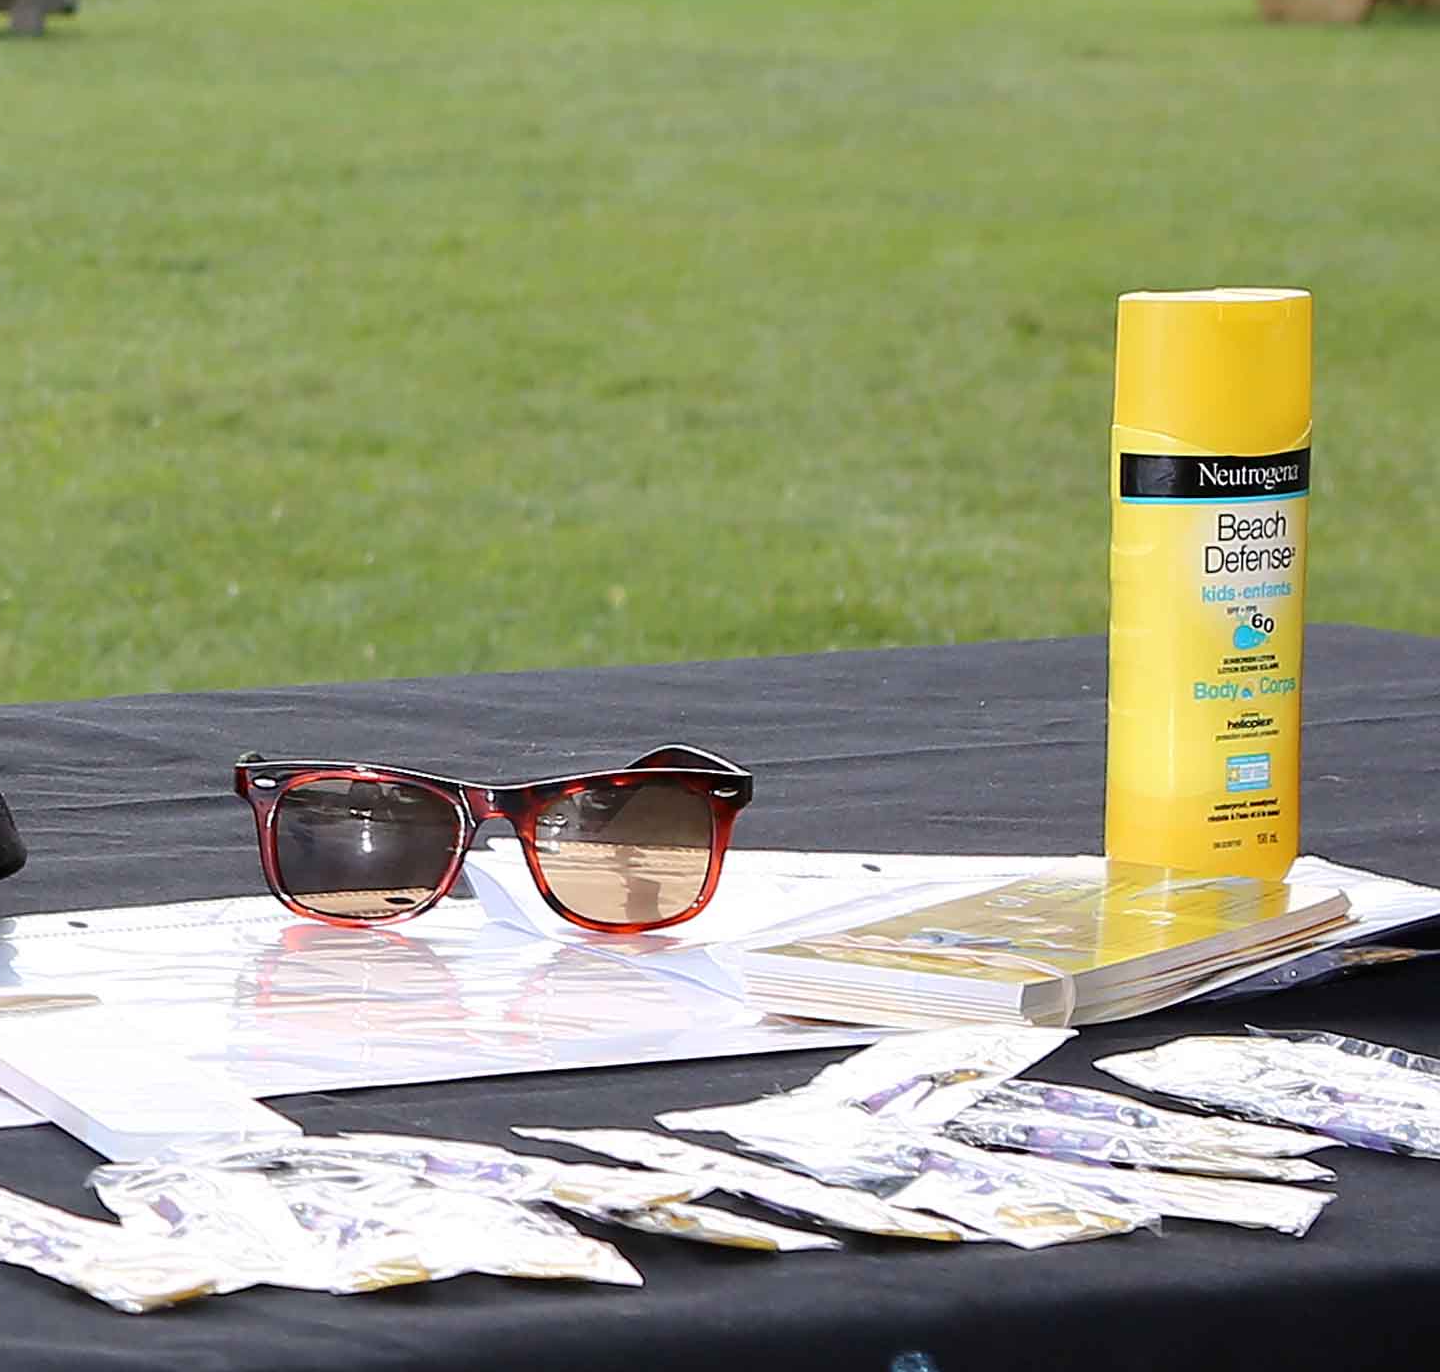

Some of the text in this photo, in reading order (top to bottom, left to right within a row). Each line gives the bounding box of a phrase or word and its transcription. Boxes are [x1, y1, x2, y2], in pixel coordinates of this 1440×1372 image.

[1198, 461, 1299, 490] Neutrogena
[1217, 511, 1287, 542] Beach
[1204, 546, 1293, 574] Defense
[1202, 585, 1235, 603] kids
[1251, 613, 1275, 634] 60
[1193, 681, 1239, 702] Body
